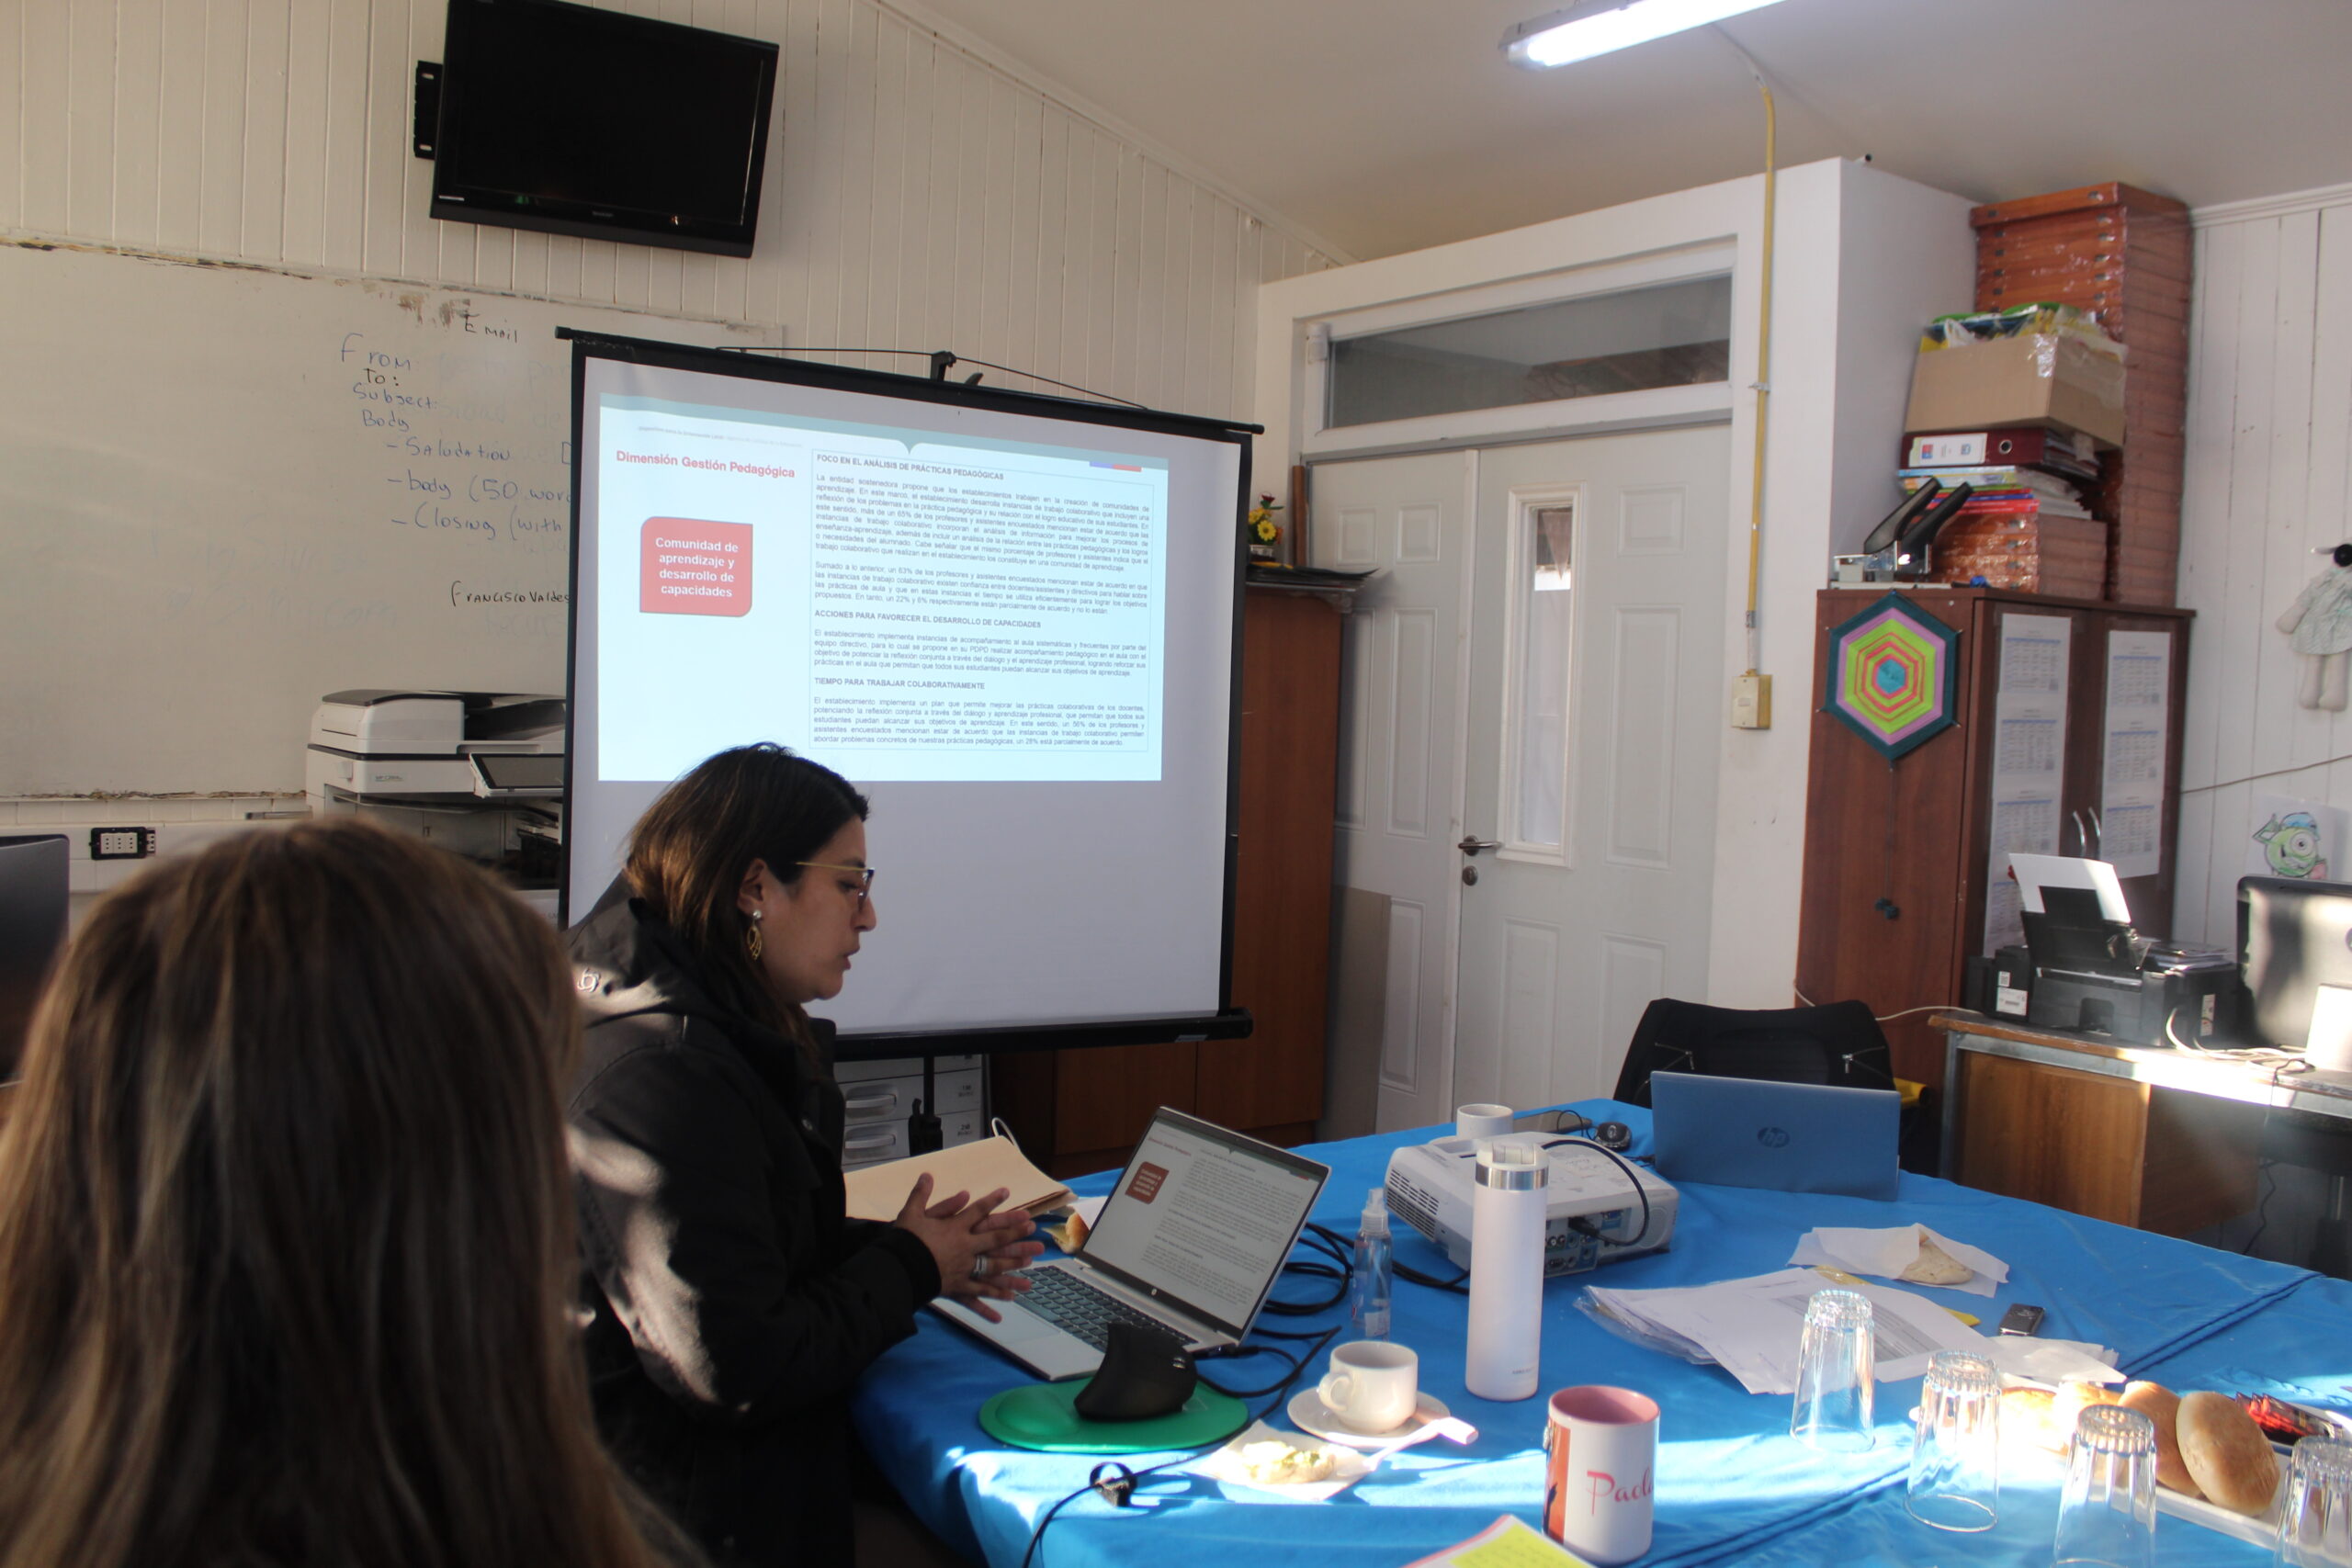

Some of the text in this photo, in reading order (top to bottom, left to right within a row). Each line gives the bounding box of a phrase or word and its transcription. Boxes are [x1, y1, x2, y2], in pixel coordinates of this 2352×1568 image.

[362, 409, 410, 432] Body
[616, 450, 796, 478] Dimensión Gestión Pedagógica
[816, 454, 838, 463] FOCO
[864, 457, 897, 468] ANÁLISIS
[910, 463, 951, 474] PRÁCTICAS
[953, 467, 1003, 479] PEDAGÓGICAS
[655, 537, 739, 553] Comunidad de
[659, 554, 735, 570] aprendizaje y
[659, 569, 735, 582] desarrollo de
[661, 585, 733, 597] capacidades
[815, 610, 854, 618] ACCIONES
[876, 613, 921, 621] FAVORECER
[933, 615, 980, 625] DESARROLLO
[993, 619, 1041, 627] CAPACIDADES
[907, 680, 985, 689] COLABORATIVAMENTE
[1759, 1127, 1789, 1148] hp
